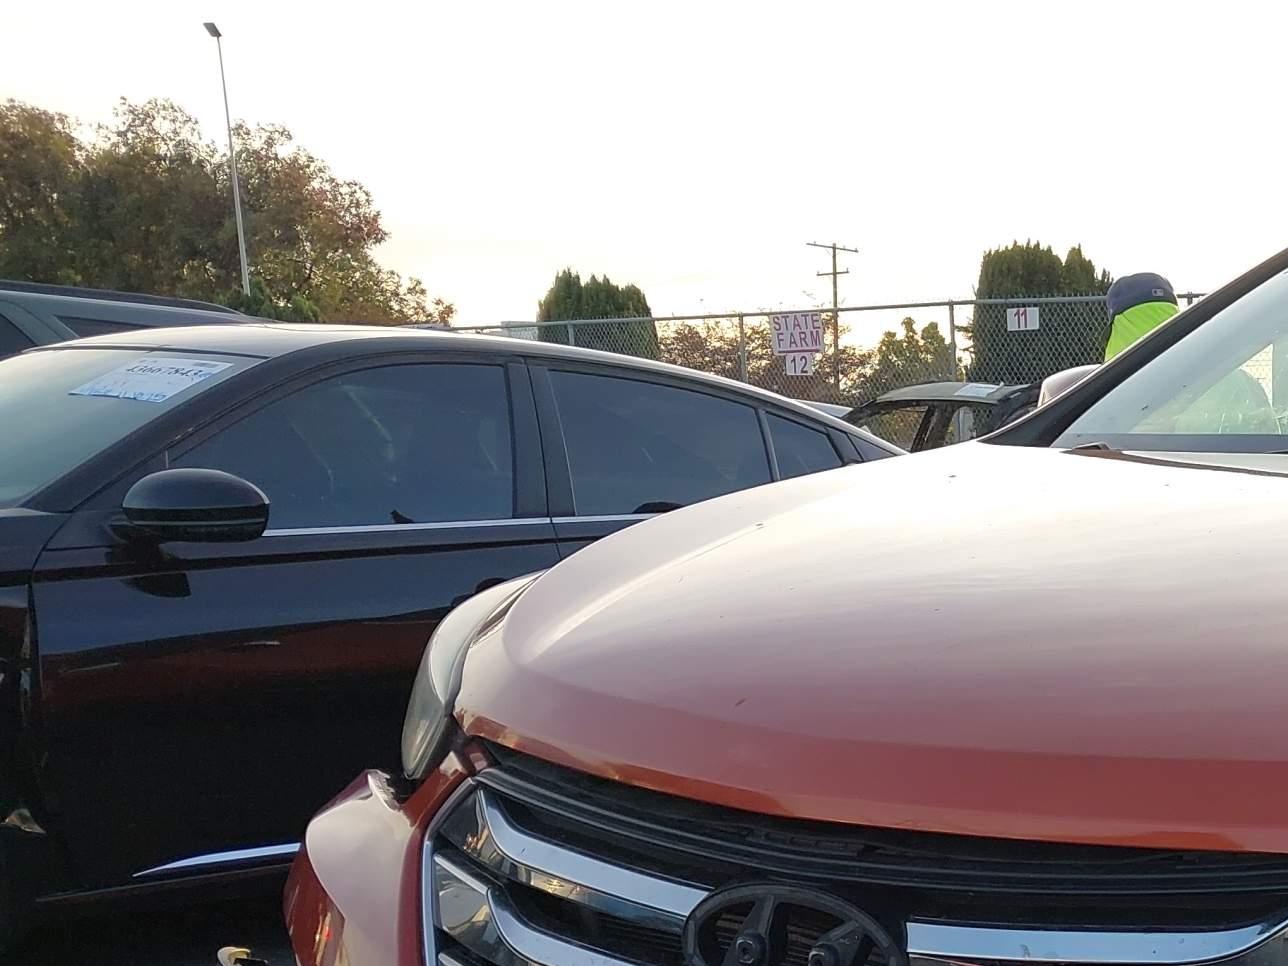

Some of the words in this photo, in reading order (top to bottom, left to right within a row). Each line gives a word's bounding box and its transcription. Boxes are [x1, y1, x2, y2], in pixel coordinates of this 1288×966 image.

[773, 313, 821, 331] STATE
[1014, 308, 1027, 328] 11
[777, 330, 821, 348] FARM
[791, 355, 808, 374] 12
